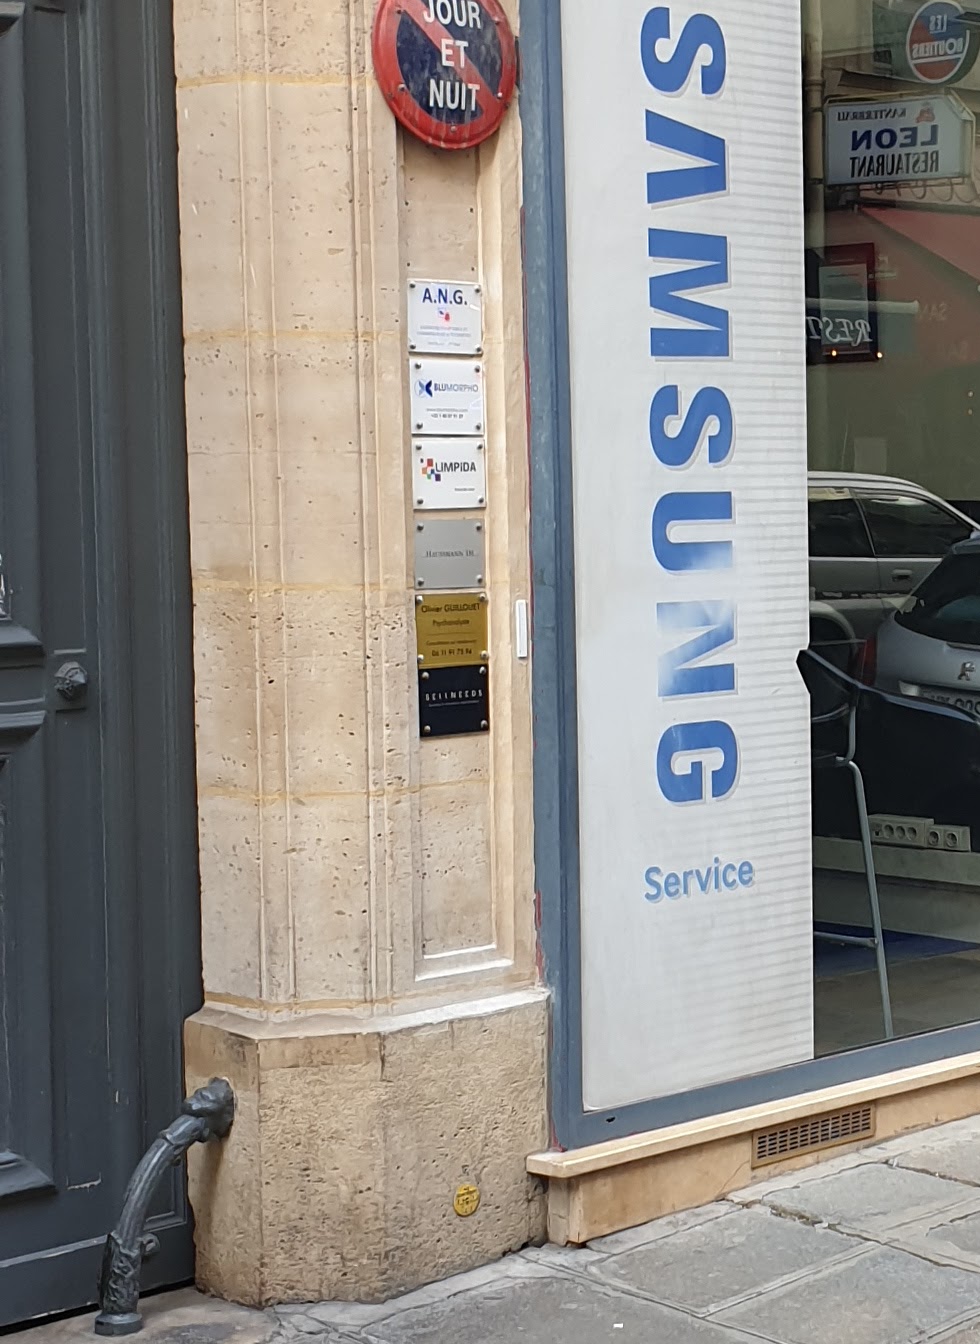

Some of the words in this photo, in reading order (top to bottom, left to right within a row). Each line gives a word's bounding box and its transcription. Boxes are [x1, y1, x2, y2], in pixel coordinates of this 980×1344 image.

[440, 38, 469, 69] ET
[429, 78, 481, 112] NUIT
[422, 287, 468, 306] A.N.G.
[640, 6, 740, 805] SAMSUNG
[643, 856, 755, 903] Service
